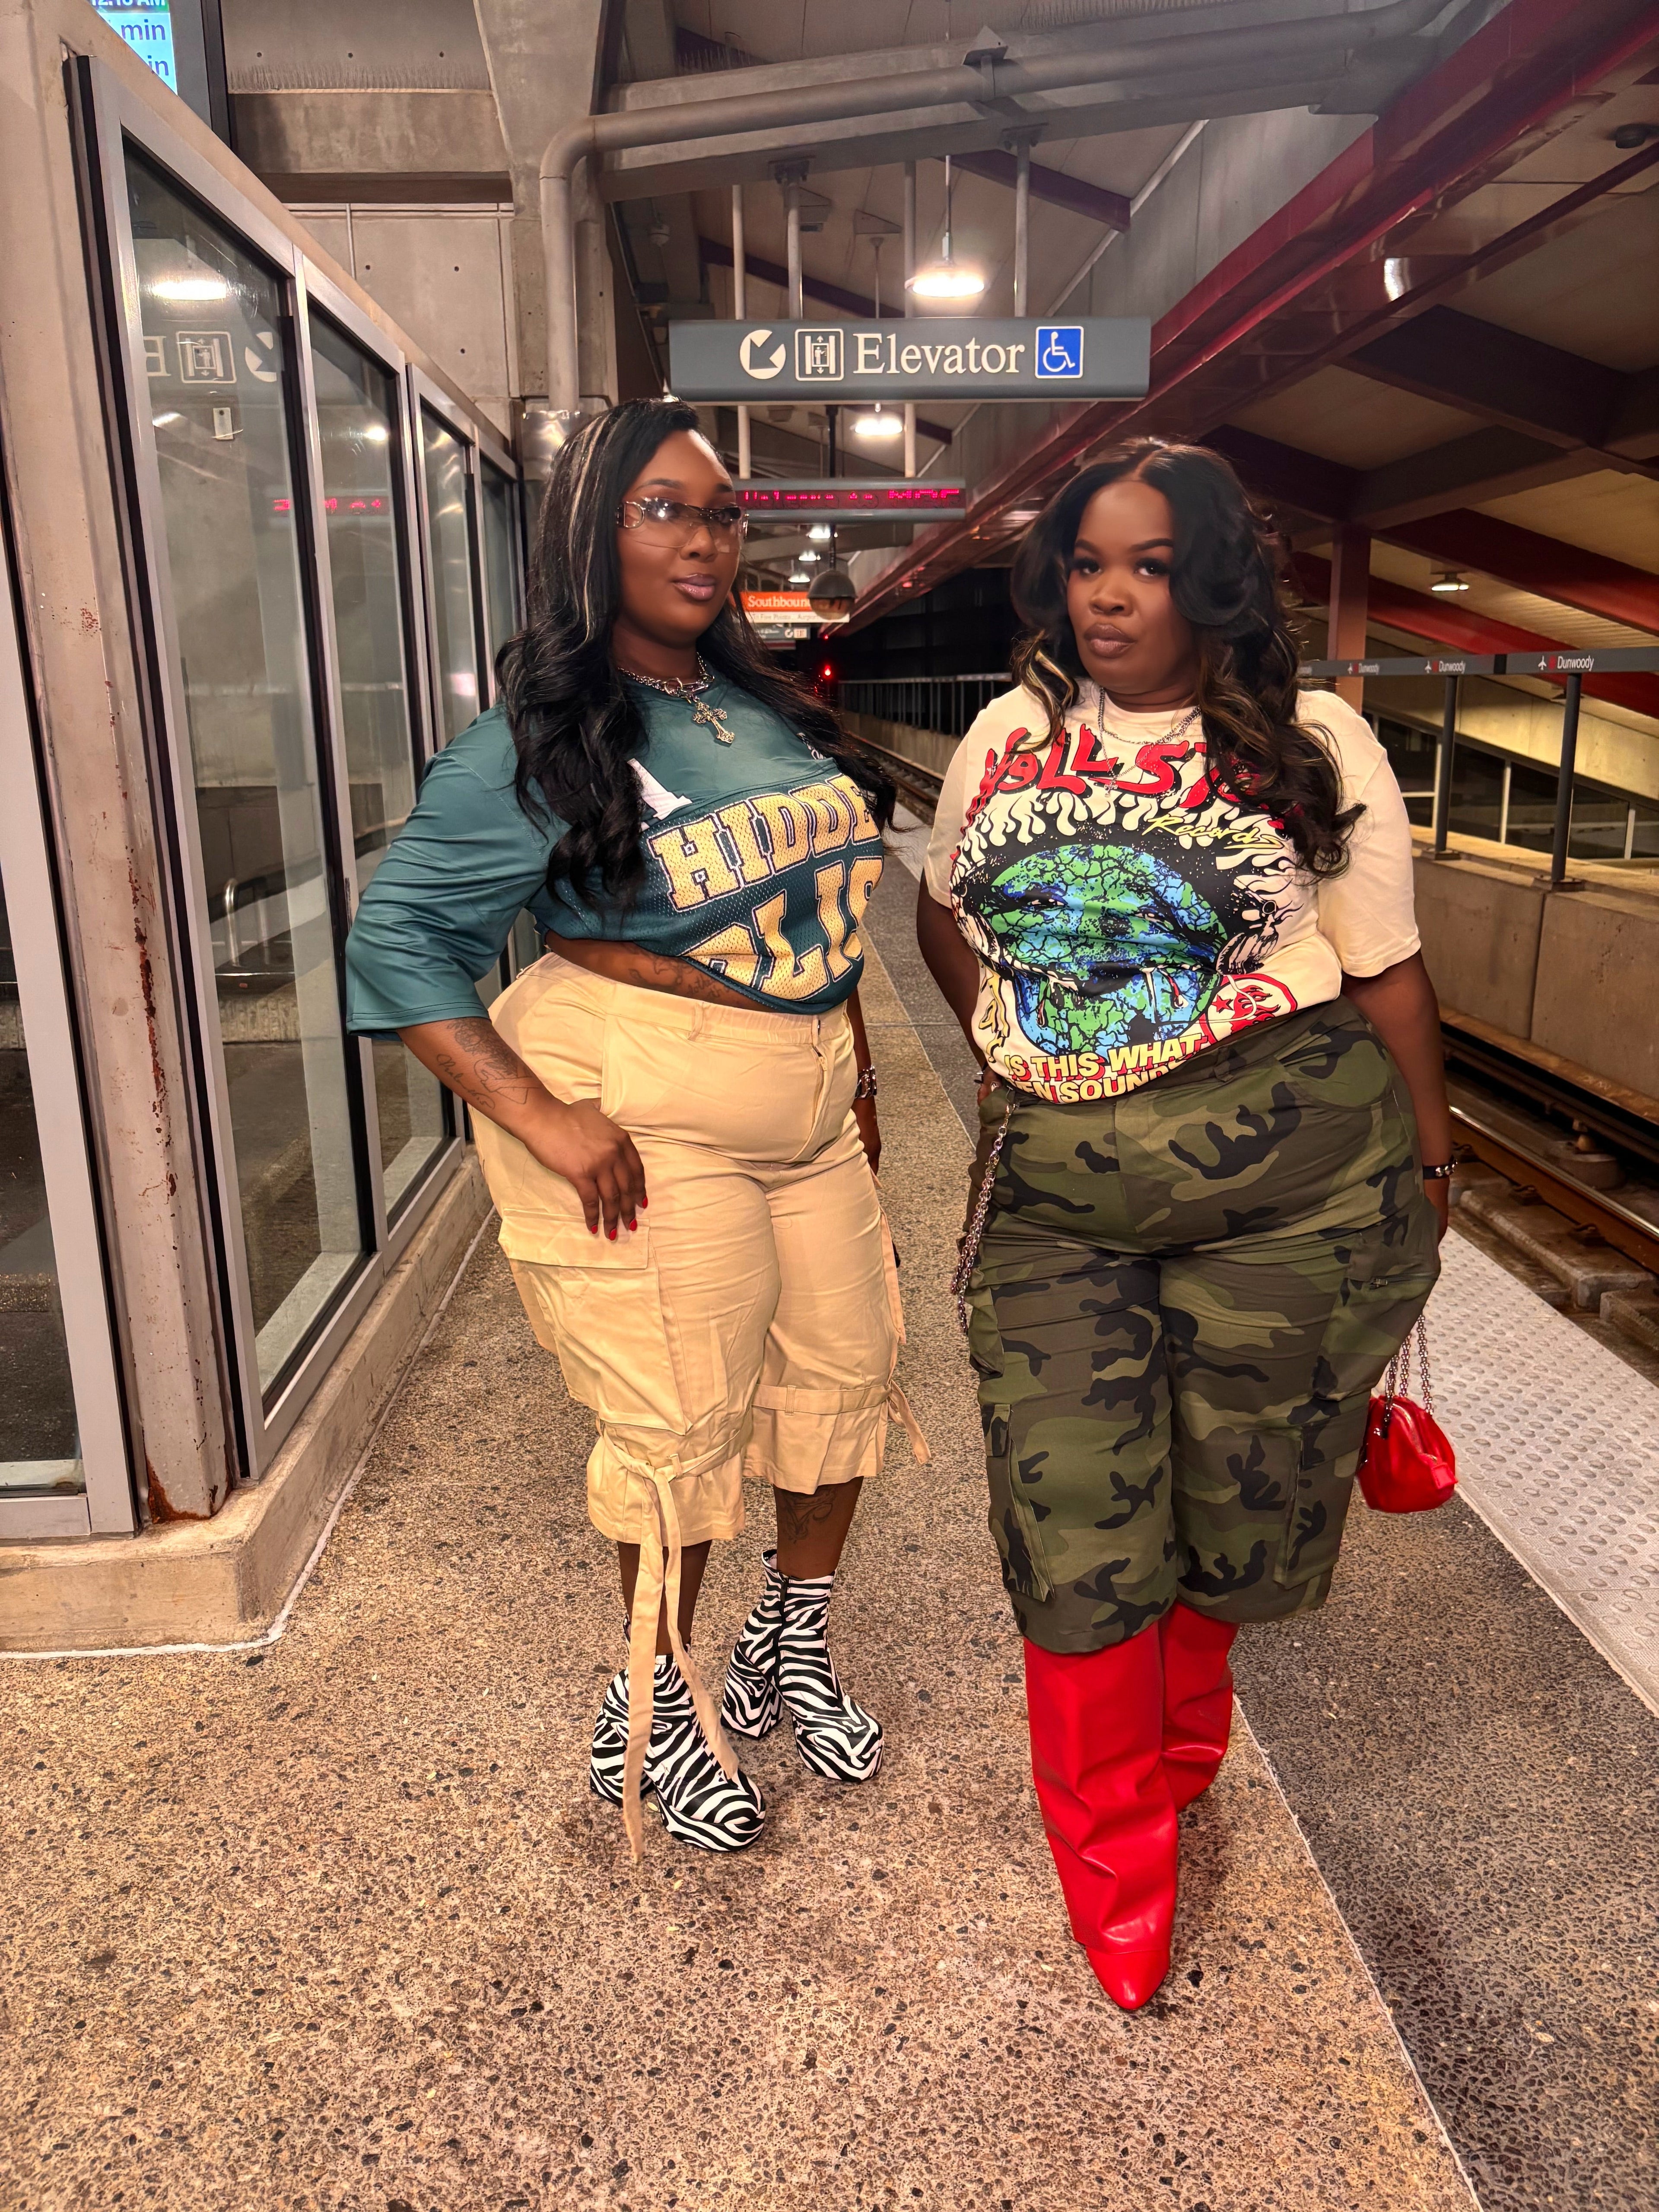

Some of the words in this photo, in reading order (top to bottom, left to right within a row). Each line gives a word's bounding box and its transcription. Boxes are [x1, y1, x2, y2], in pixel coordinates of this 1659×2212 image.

[121, 19, 166, 40] min
[147, 55, 169, 76] in
[853, 333, 1025, 375] Elevator
[1438, 661, 1466, 673] Dunwoody
[1557, 655, 1594, 672] Dunwoody
[1145, 815, 1285, 850] Records
[1004, 1054, 1033, 1081] IS
[1030, 1051, 1104, 1081] THIS
[1107, 1033, 1208, 1076] WHAT
